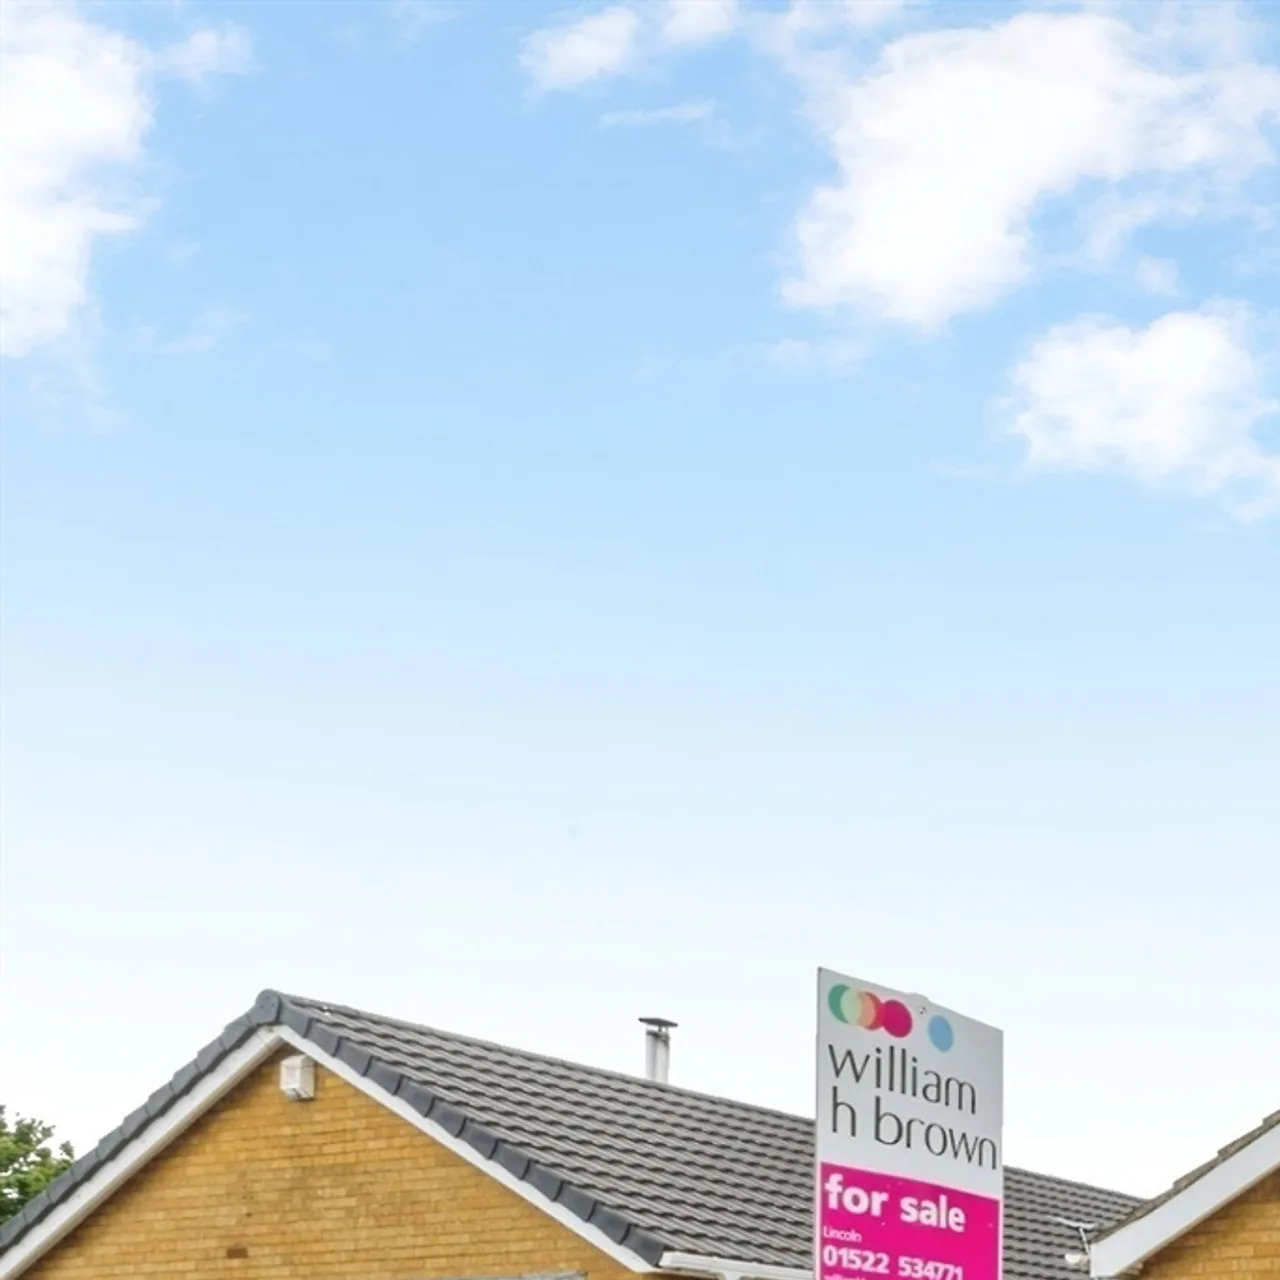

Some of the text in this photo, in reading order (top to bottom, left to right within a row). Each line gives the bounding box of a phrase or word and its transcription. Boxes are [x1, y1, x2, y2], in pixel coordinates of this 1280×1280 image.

[828, 1044, 976, 1114] william
[832, 1085, 997, 1170] h brown
[823, 1225, 863, 1243] Lincoln
[825, 1174, 967, 1234] for sale
[823, 1245, 890, 1275] 01522
